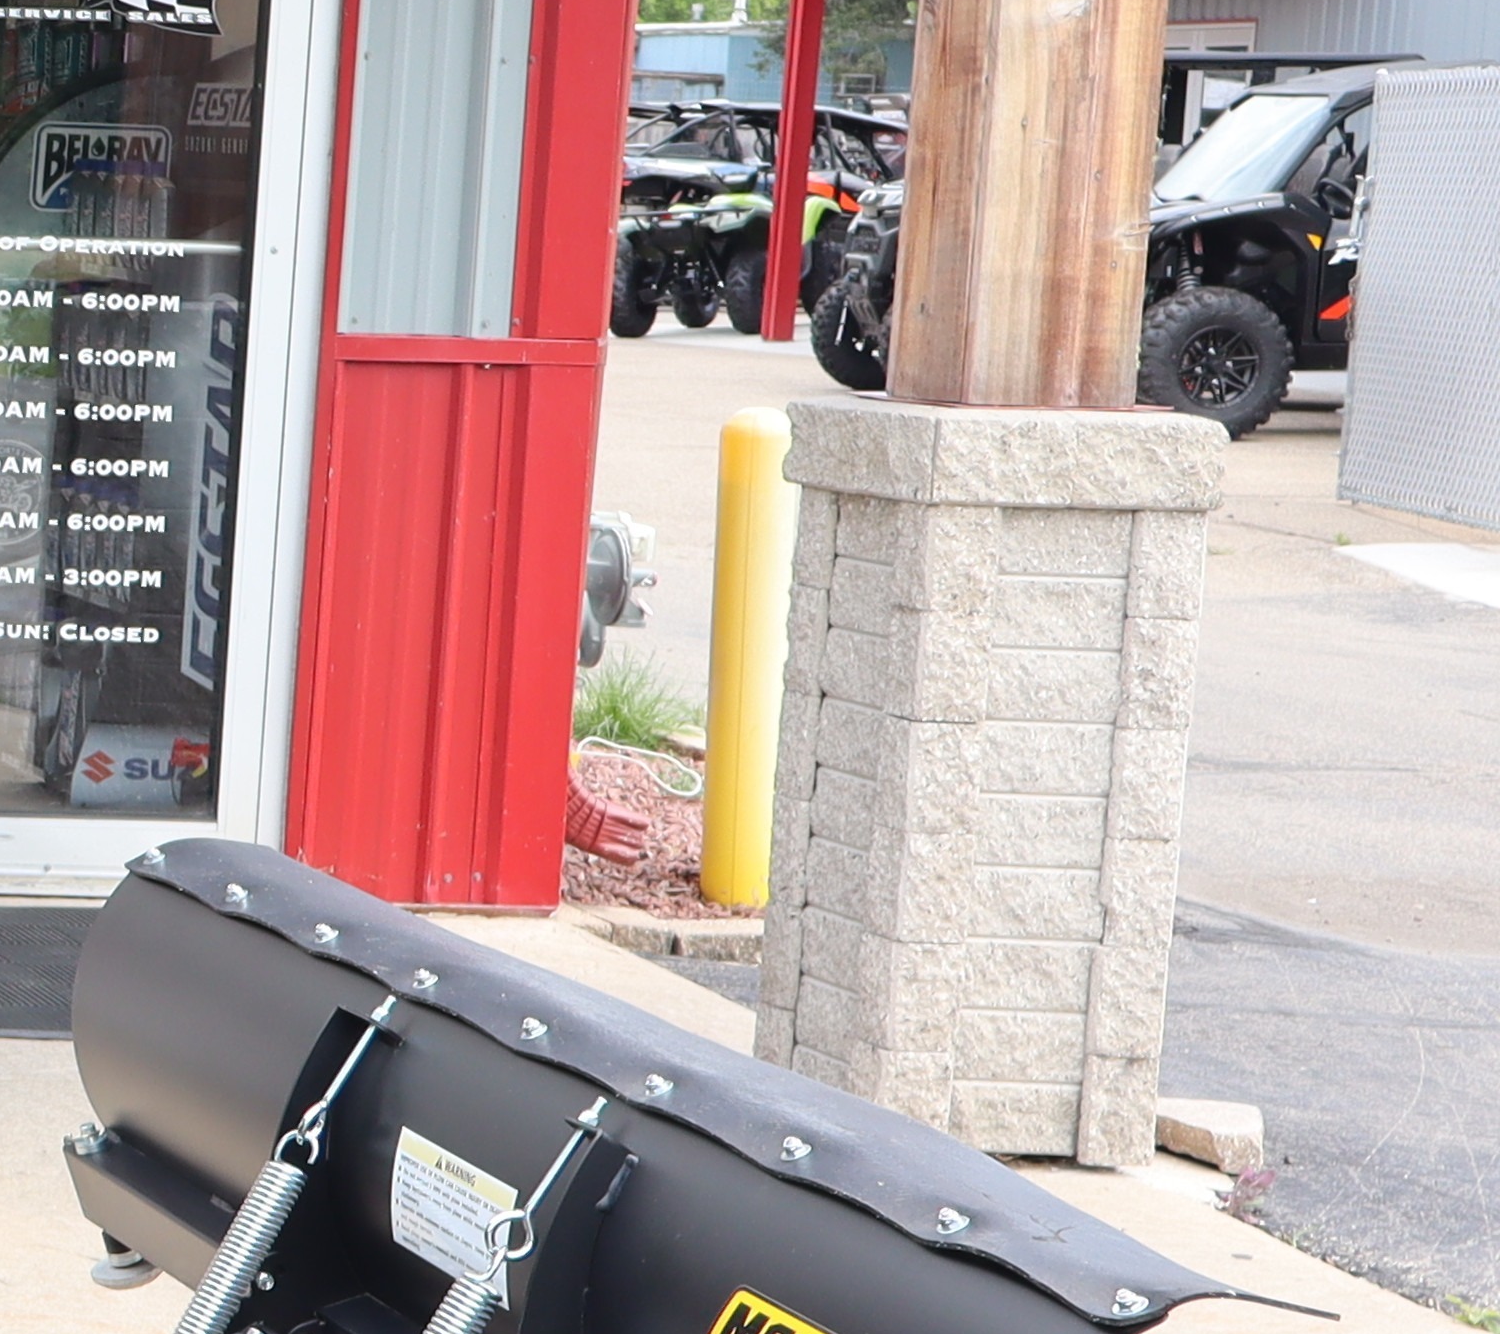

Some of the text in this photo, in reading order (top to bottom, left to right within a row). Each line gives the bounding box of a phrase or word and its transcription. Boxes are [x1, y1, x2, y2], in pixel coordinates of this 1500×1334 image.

[127, 11, 215, 25] SALES
[190, 86, 253, 123] ECSTA
[81, 292, 181, 313] 6:00PM
[77, 347, 177, 368] 6:00PM
[73, 402, 174, 423] 6:00PM
[70, 457, 170, 478] 6:00PM
[66, 513, 166, 534] 6:00PM
[62, 568, 163, 589] 3:00PM
[444, 1160, 477, 1188] WARNING
